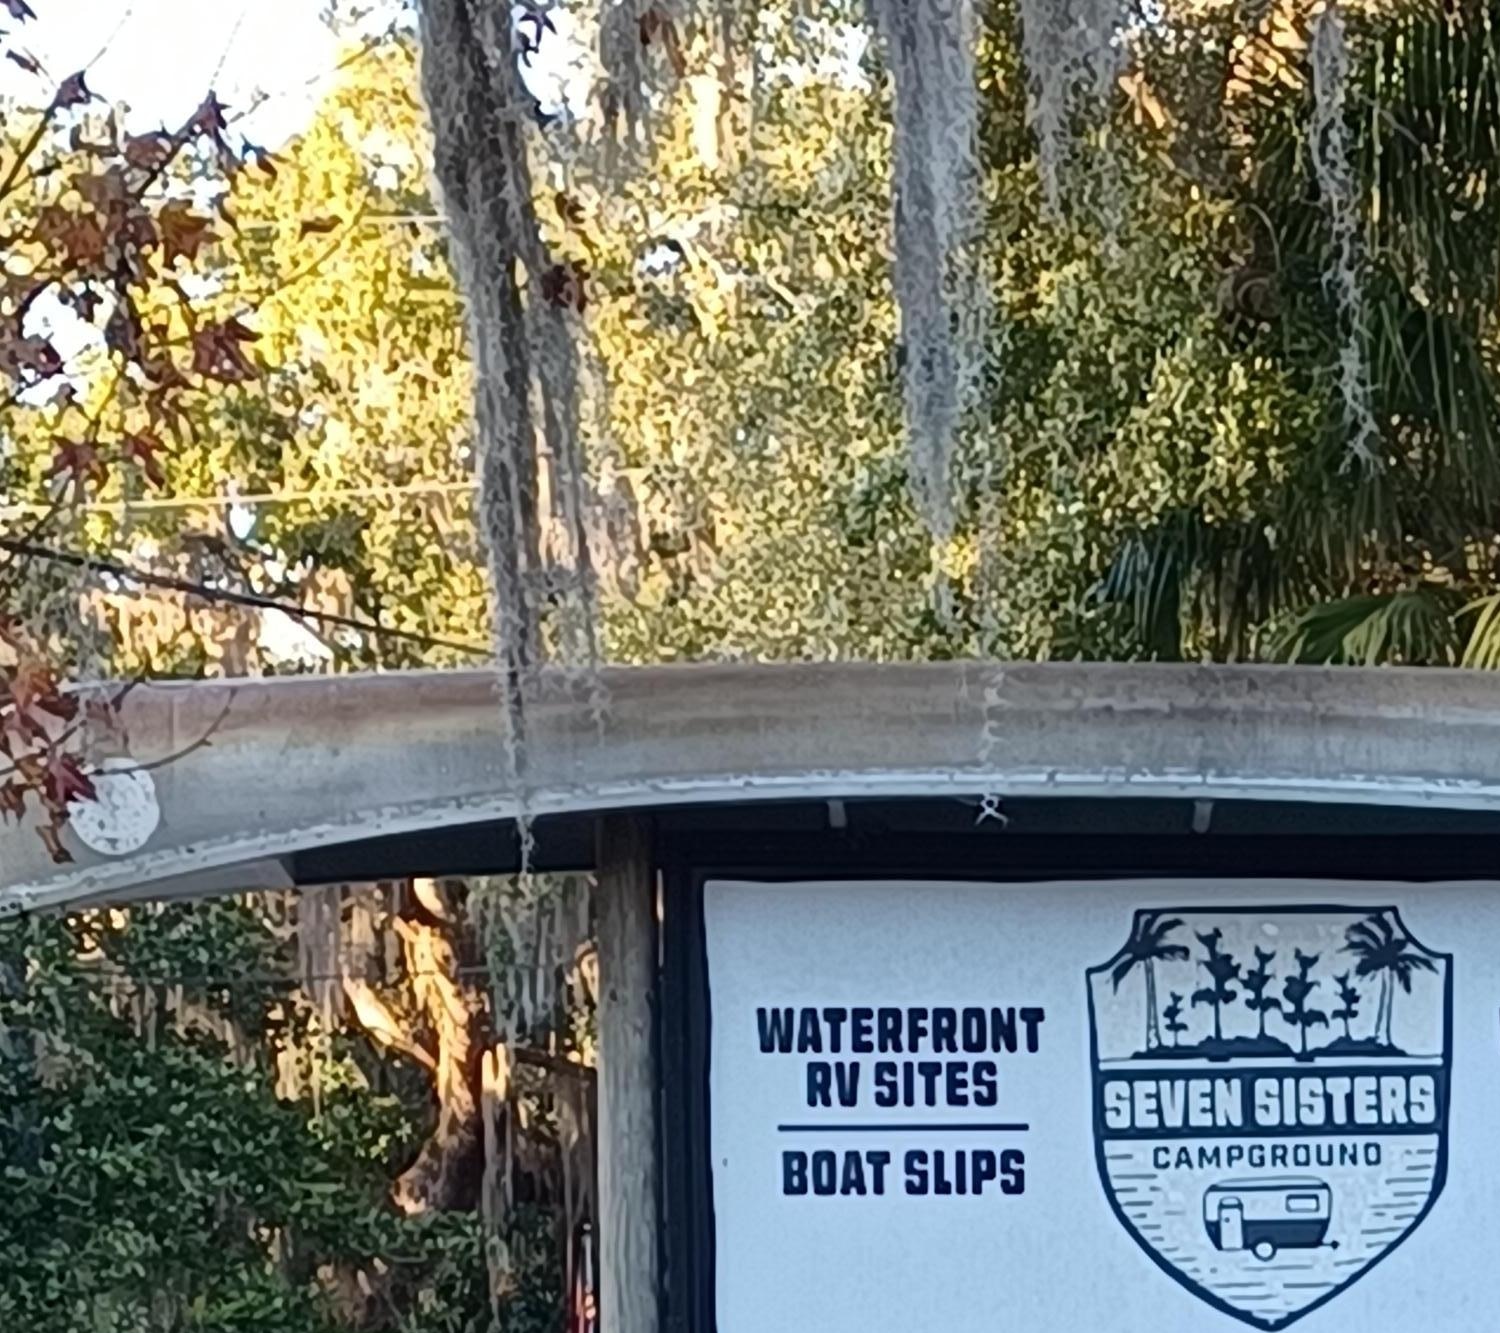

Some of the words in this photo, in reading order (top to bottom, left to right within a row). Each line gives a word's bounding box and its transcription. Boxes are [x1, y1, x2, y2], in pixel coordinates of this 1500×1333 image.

[757, 1007, 1045, 1053] WATERFRONT
[807, 1062, 860, 1107] RV
[875, 1061, 997, 1107] SITES
[1105, 1079, 1242, 1128] SEVEN
[1255, 1076, 1435, 1125] SISTERS
[783, 1150, 890, 1195] BOAT
[905, 1149, 1024, 1195] SLIPS
[1153, 1143, 1381, 1169] CAMPGROUND
